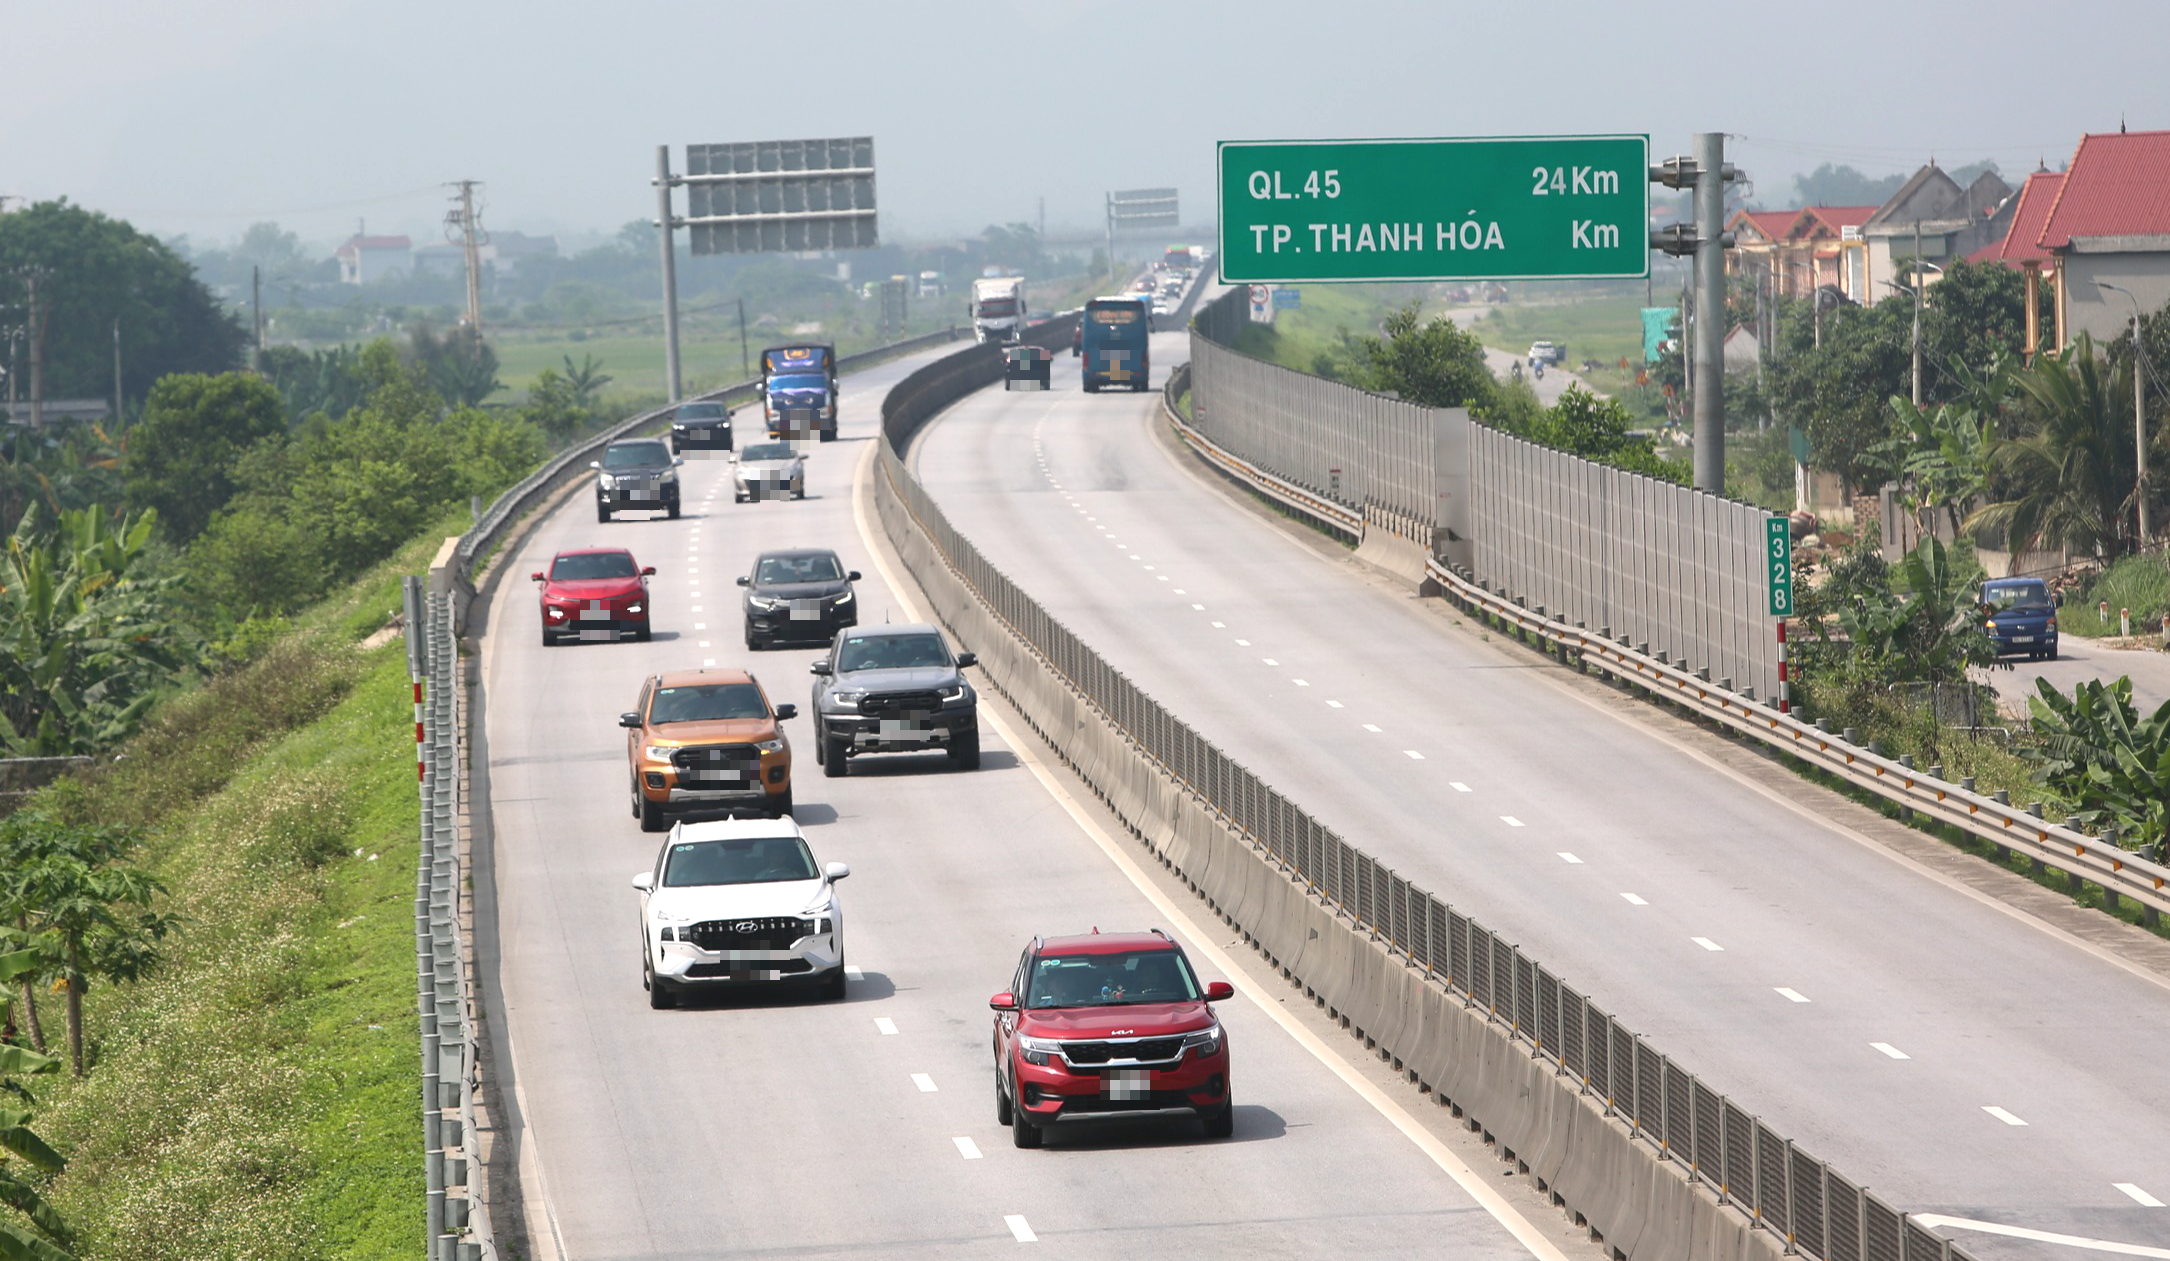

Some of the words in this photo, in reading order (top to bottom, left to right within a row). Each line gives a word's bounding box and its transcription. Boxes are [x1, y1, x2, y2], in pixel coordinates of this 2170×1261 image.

[1248, 169, 1341, 200] QL.45
[1249, 224, 1301, 254] TP.
[1308, 222, 1423, 253] THANH
[1436, 209, 1505, 251] HÓA
[1572, 219, 1619, 249] Km
[1771, 523, 1783, 533] Km
